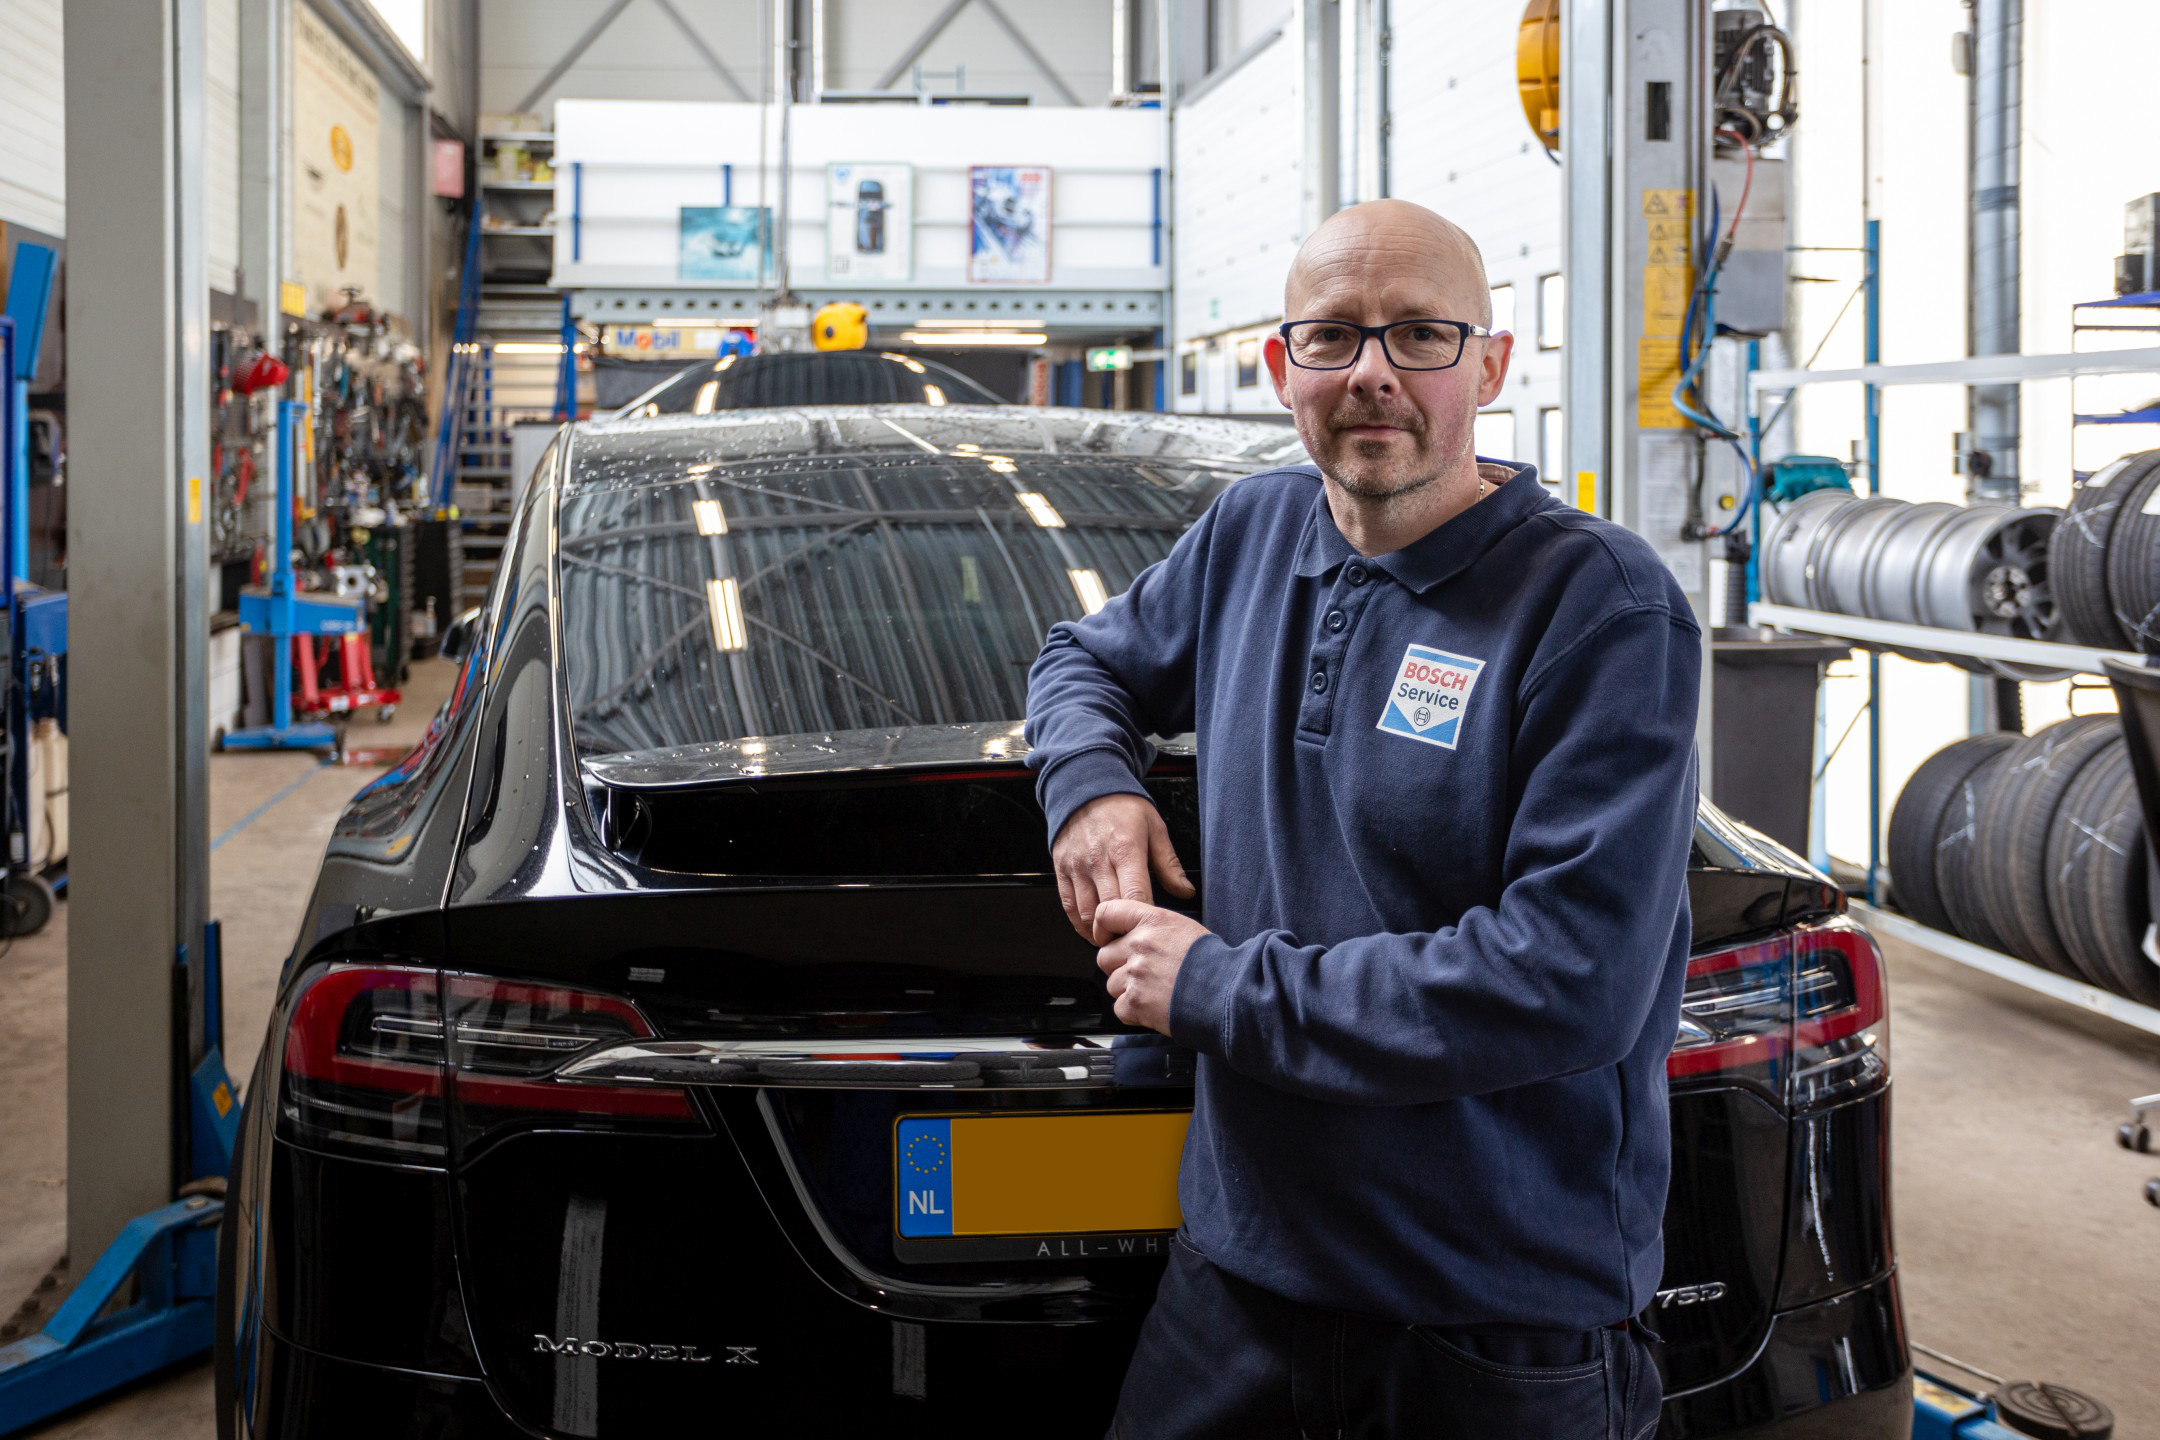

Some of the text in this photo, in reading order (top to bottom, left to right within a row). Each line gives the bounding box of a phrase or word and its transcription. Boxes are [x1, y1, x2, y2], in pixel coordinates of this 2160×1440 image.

[616, 329, 679, 349] Mobil
[1403, 661, 1469, 691] BOSCH
[1397, 682, 1459, 710] Service
[908, 1189, 945, 1215] NL
[1655, 1281, 1728, 1309] 75D
[534, 1334, 759, 1364] MODEL X
